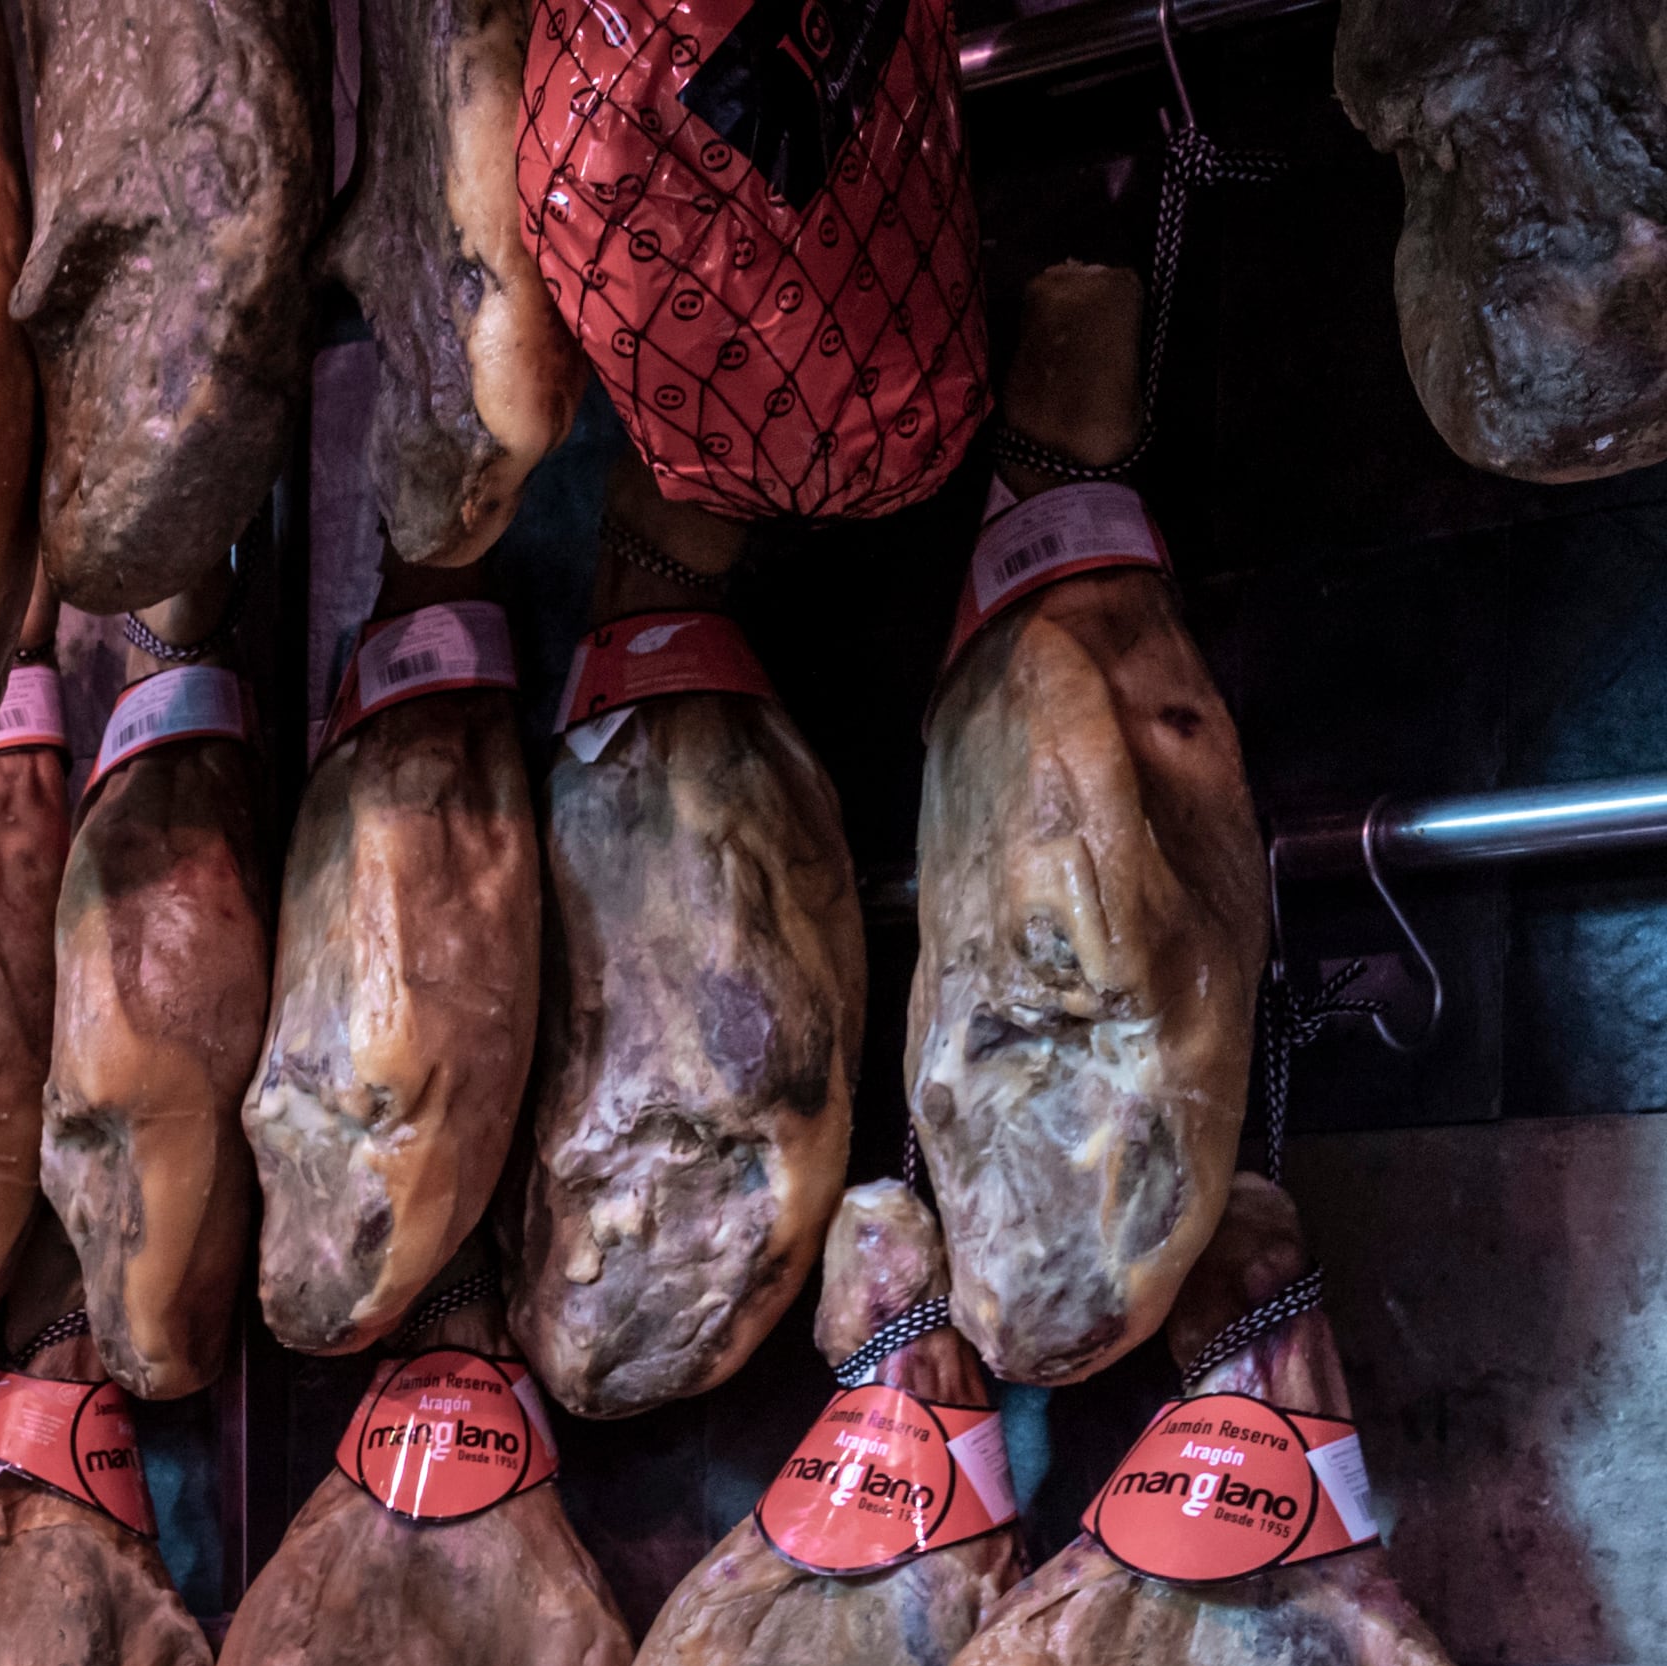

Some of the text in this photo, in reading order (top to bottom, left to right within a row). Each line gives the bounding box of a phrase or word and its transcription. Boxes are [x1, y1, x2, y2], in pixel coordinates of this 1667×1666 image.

[446, 1372, 503, 1395] Reserva
[419, 1394, 471, 1414] Aragón
[368, 1419, 519, 1461] manglano
[834, 1430, 890, 1457] Aragón
[1160, 1418, 1289, 1451] Jamón Reserva
[457, 1450, 518, 1470] Desde 1955
[1180, 1441, 1245, 1466] Aragón
[1112, 1471, 1297, 1521] manglano
[1214, 1508, 1291, 1538] Desde 1955
